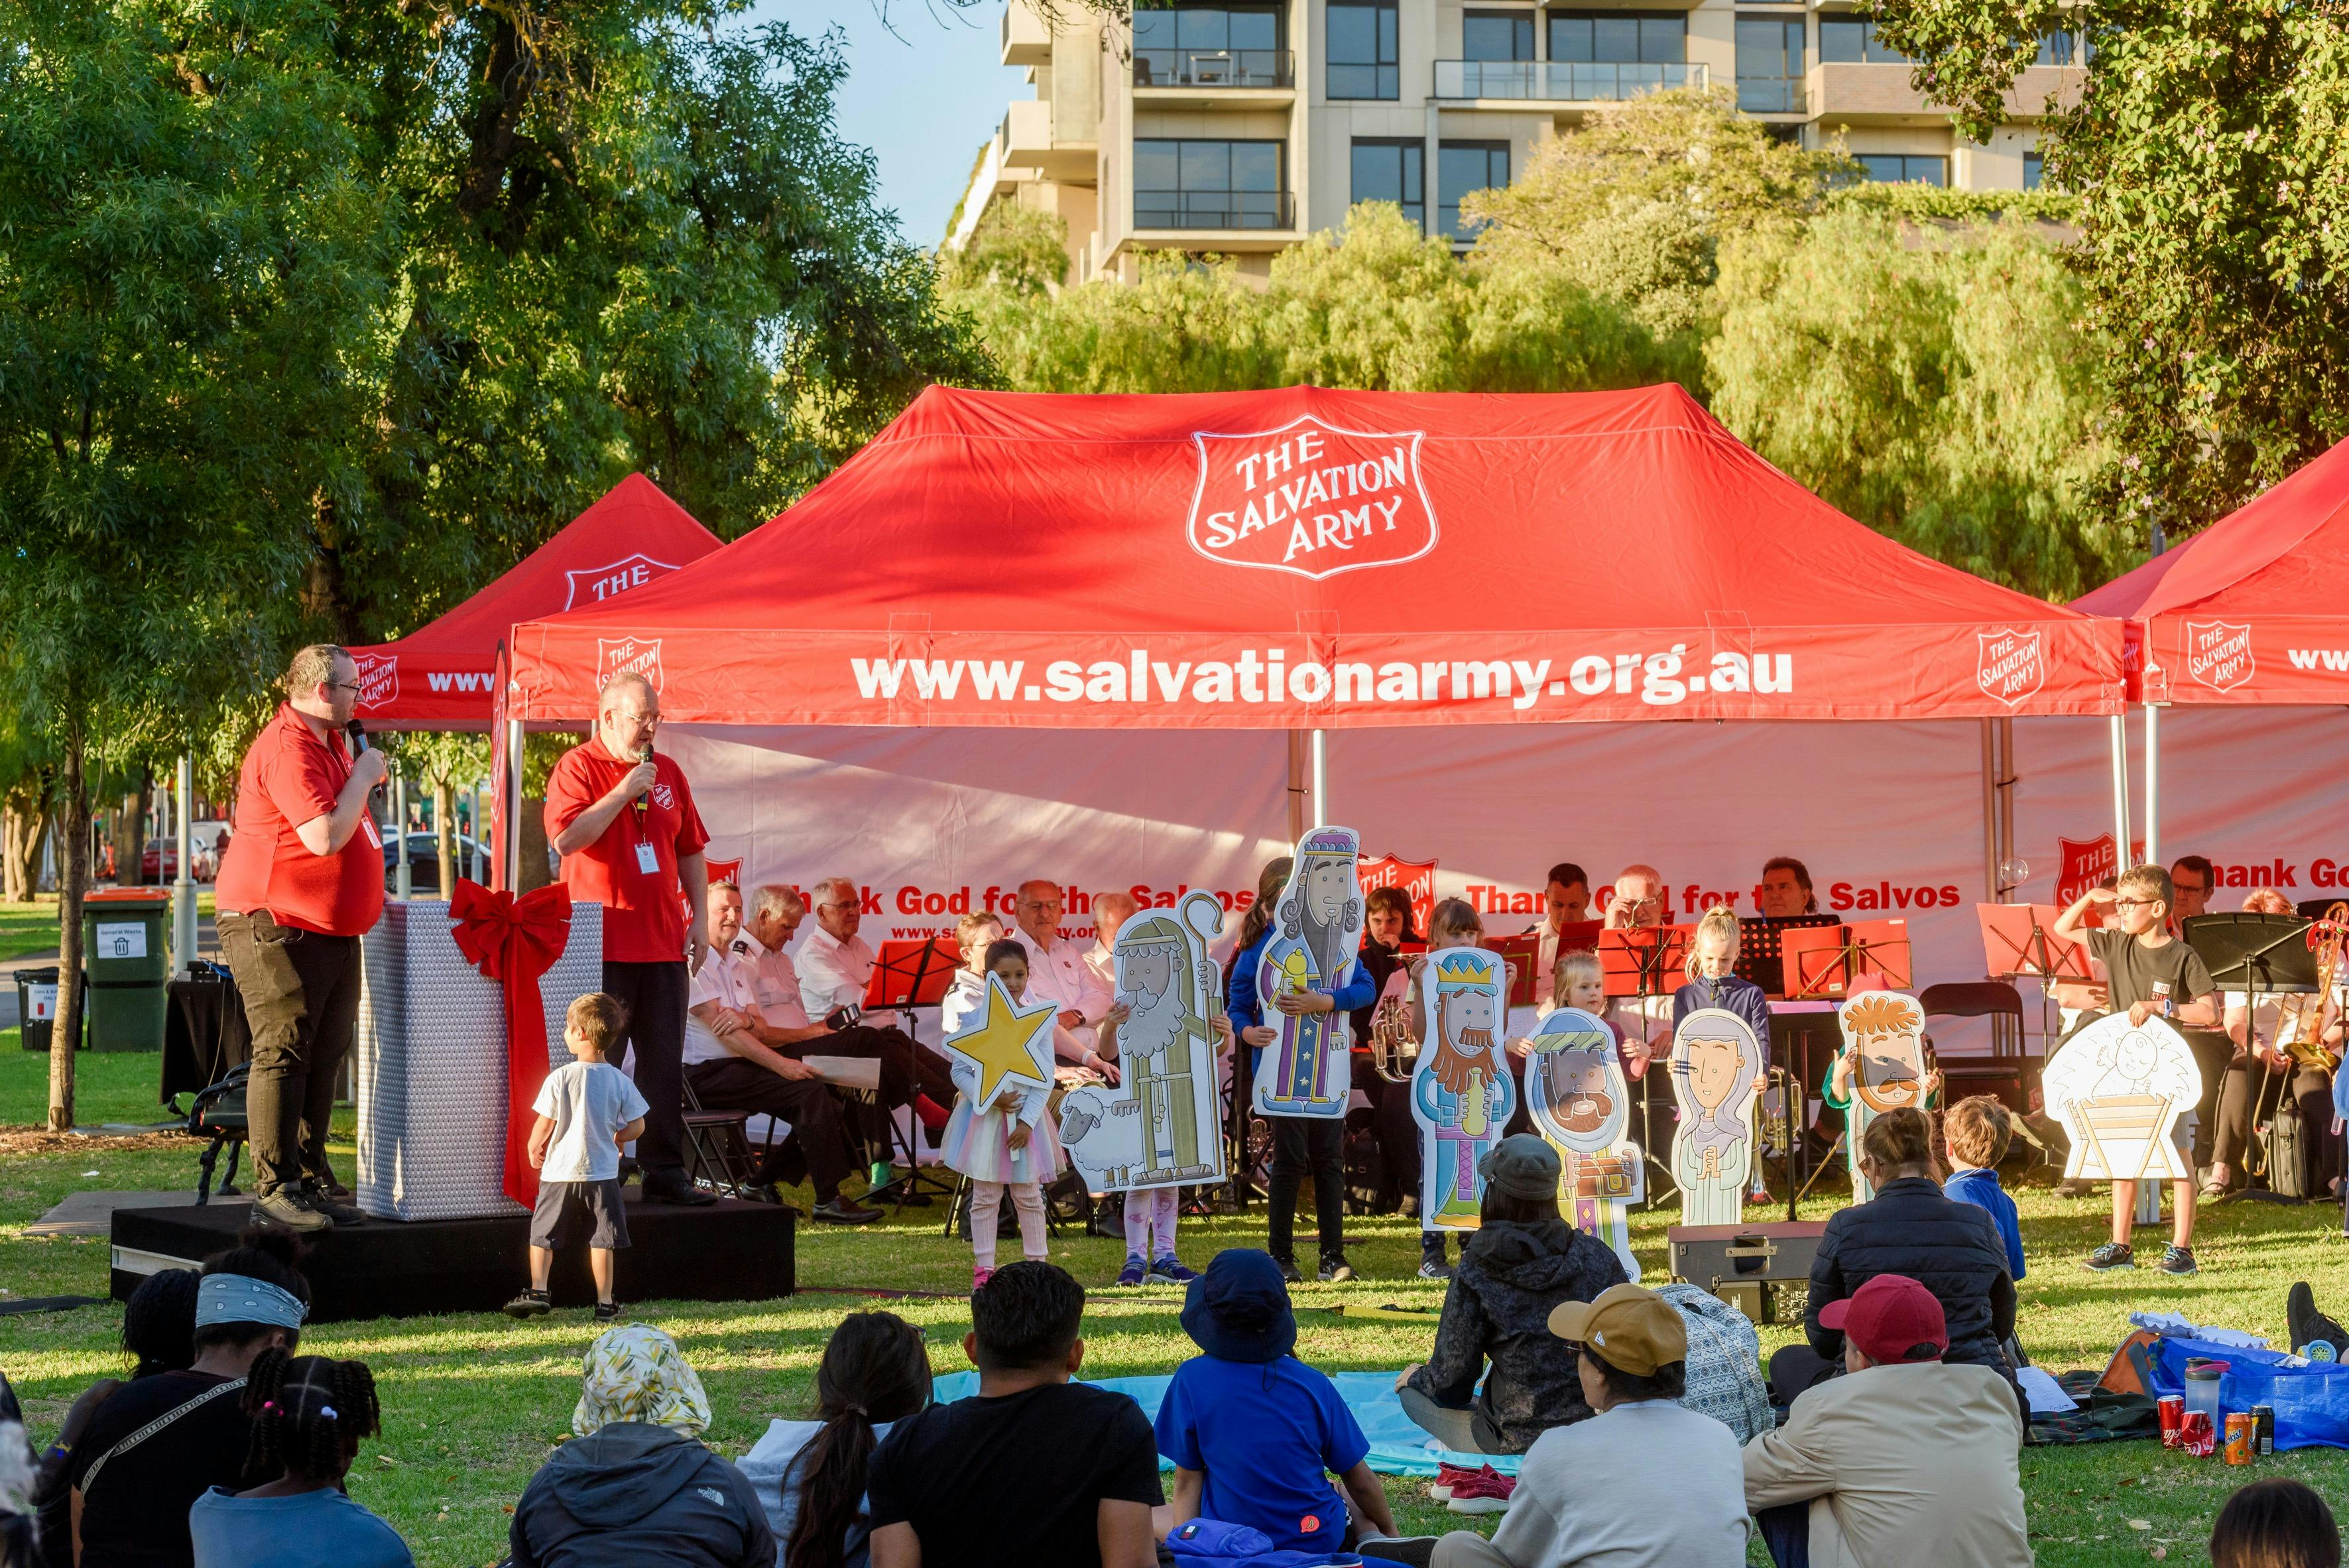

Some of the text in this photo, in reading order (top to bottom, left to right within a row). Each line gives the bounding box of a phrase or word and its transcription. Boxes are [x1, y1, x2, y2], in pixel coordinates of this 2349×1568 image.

[1236, 431, 1325, 492] THE
[1205, 447, 1406, 548] SALVATION
[1282, 495, 1404, 563] ARMY
[592, 564, 650, 601] THE
[609, 642, 634, 667] THE
[1990, 636, 2014, 661] THE
[2193, 631, 2246, 675] SALVATION
[2199, 627, 2224, 650] THE
[355, 657, 376, 674] THE
[360, 662, 393, 690] LVATION
[851, 643, 1793, 710] www.salvationarmy.org.au
[1982, 639, 2036, 688] SALVATION
[2002, 661, 2035, 697] ARMY
[2214, 652, 2245, 685] ARMY
[365, 677, 392, 703] ARMY
[2076, 843, 2114, 876] THE
[1360, 864, 1398, 900] THE
[1829, 881, 1960, 911] Salvos
[896, 886, 970, 915] God
[983, 886, 1016, 915] fo
